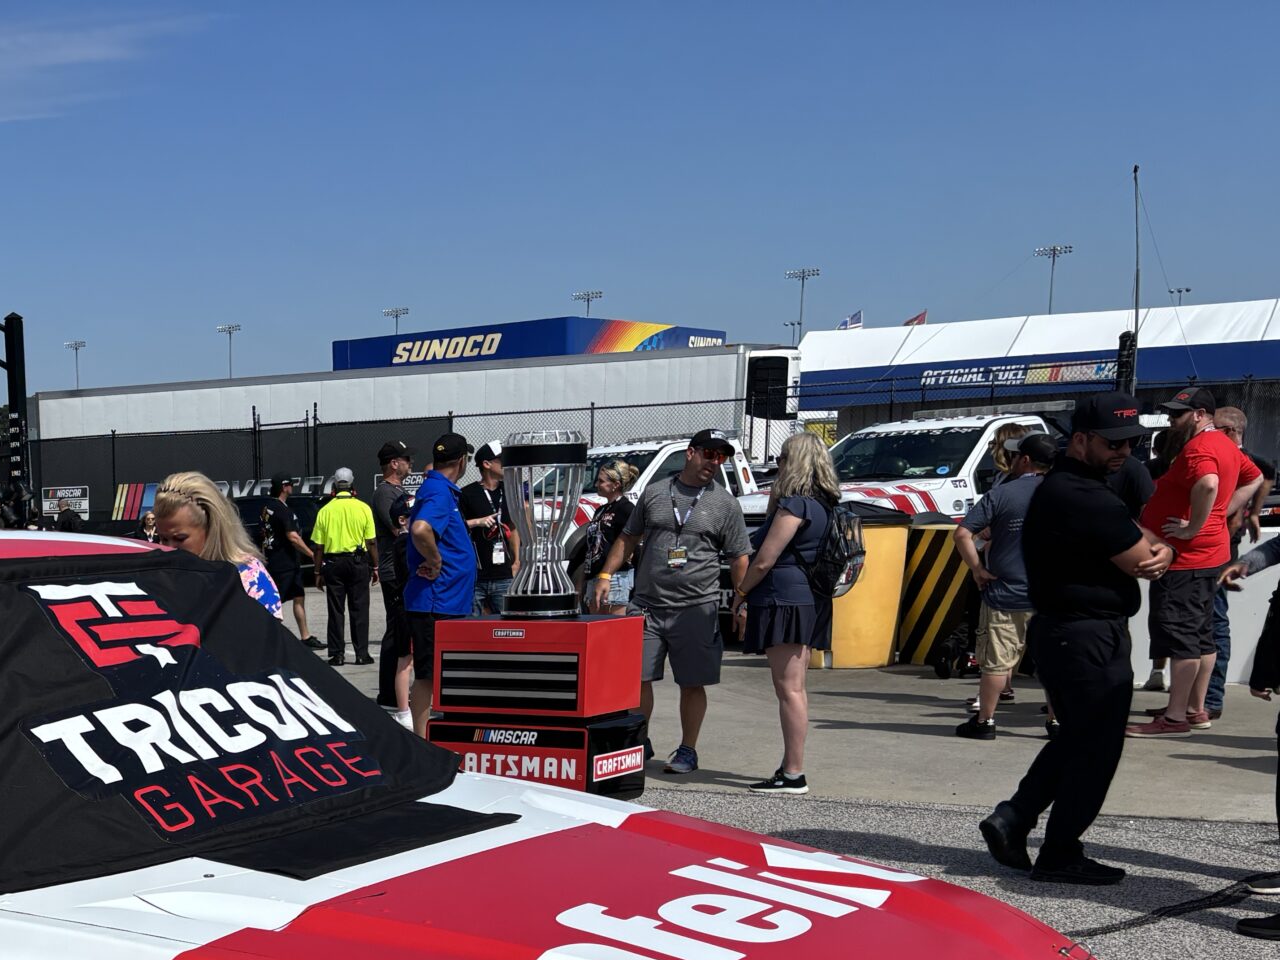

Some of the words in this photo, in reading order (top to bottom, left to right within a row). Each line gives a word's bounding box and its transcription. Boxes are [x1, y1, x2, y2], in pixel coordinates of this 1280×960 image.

[392, 332, 503, 364] SUNOCO
[1114, 408, 1138, 419] TRD
[56, 488, 82, 498] NASCAR
[494, 630, 524, 638] CRAFTSMAN
[30, 673, 356, 784] TRICON
[488, 730, 538, 746] NASCAR
[465, 752, 577, 781] AFTSMAN
[596, 750, 642, 777] CRAFTSMAN
[133, 742, 382, 832] GARAGE
